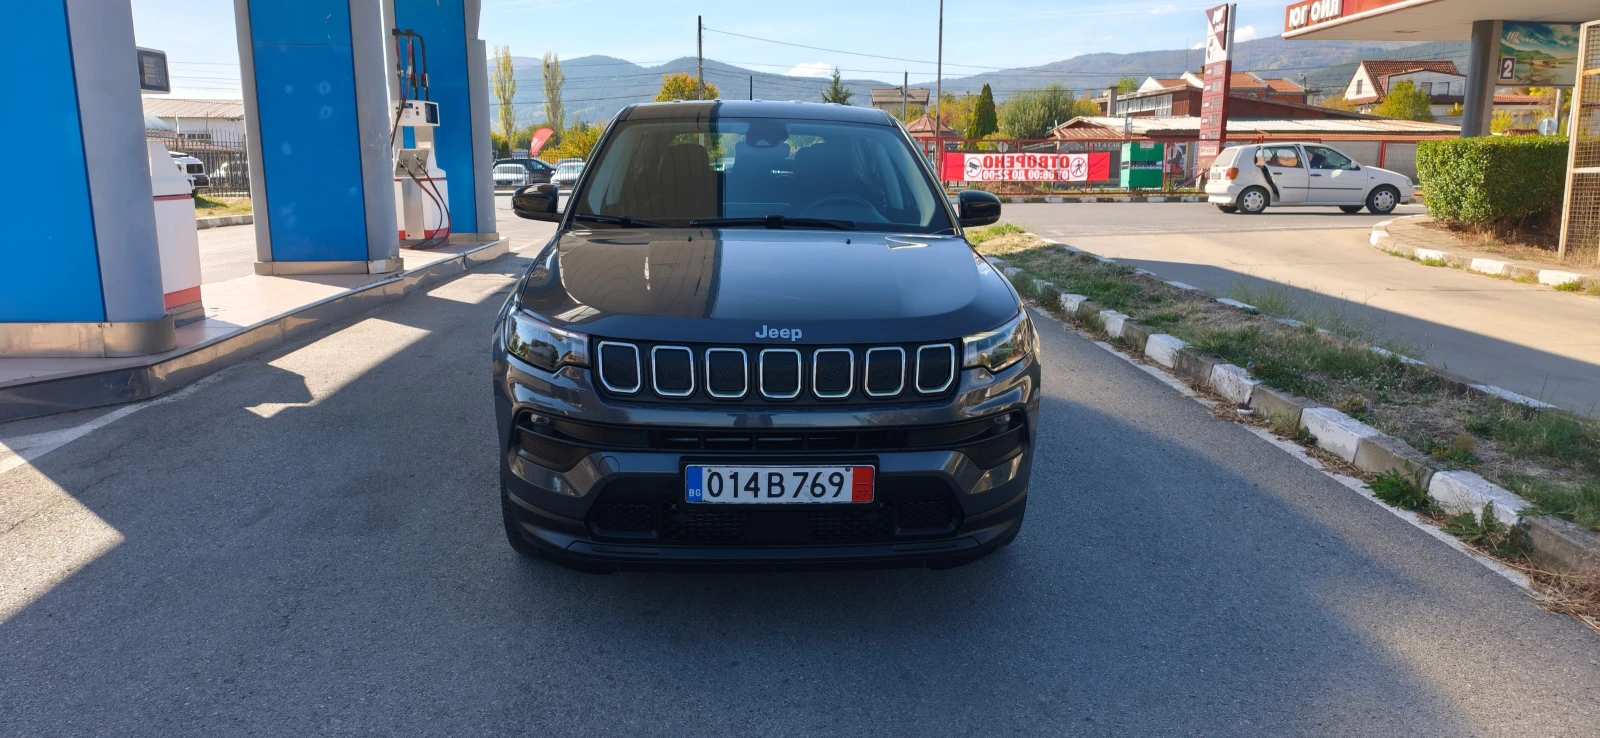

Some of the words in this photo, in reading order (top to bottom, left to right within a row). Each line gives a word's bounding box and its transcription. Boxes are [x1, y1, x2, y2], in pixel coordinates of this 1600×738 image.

[1289, 5, 1309, 27] ЮГ
[1503, 60, 1513, 77] 2
[755, 325, 803, 341] Jeep
[689, 489, 701, 497] BG
[707, 471, 845, 498] 014B769
[856, 489, 868, 498] 27
